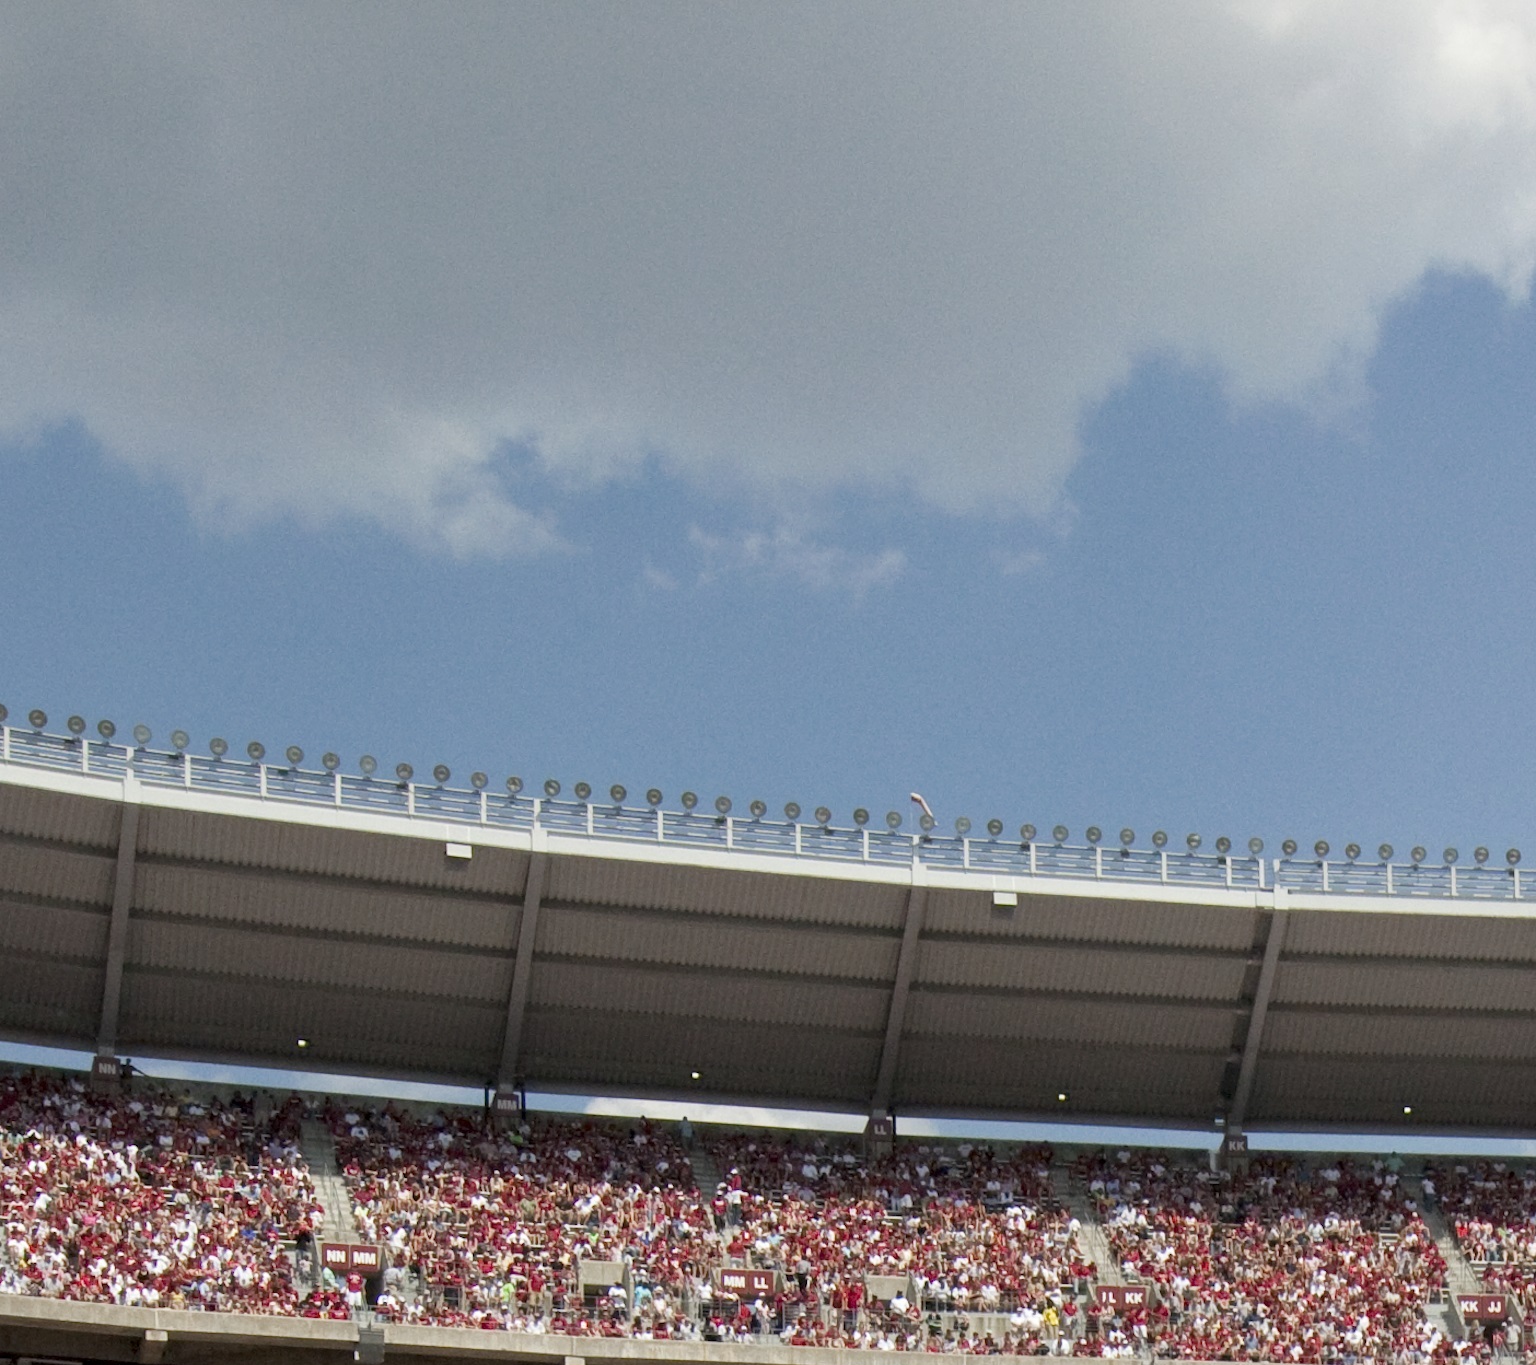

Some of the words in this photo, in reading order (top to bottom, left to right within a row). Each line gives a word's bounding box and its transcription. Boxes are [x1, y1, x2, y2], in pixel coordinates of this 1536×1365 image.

[98, 1062, 116, 1075] NN
[497, 1098, 517, 1110] MM
[872, 1124, 885, 1135] LL
[1228, 1140, 1246, 1151] KK
[326, 1249, 346, 1263] NN
[353, 1250, 376, 1265] MM
[723, 1275, 745, 1288] MM
[753, 1276, 768, 1289] LL
[1125, 1291, 1143, 1304] KK
[1460, 1301, 1478, 1312] KK
[1487, 1301, 1501, 1313] JJ
